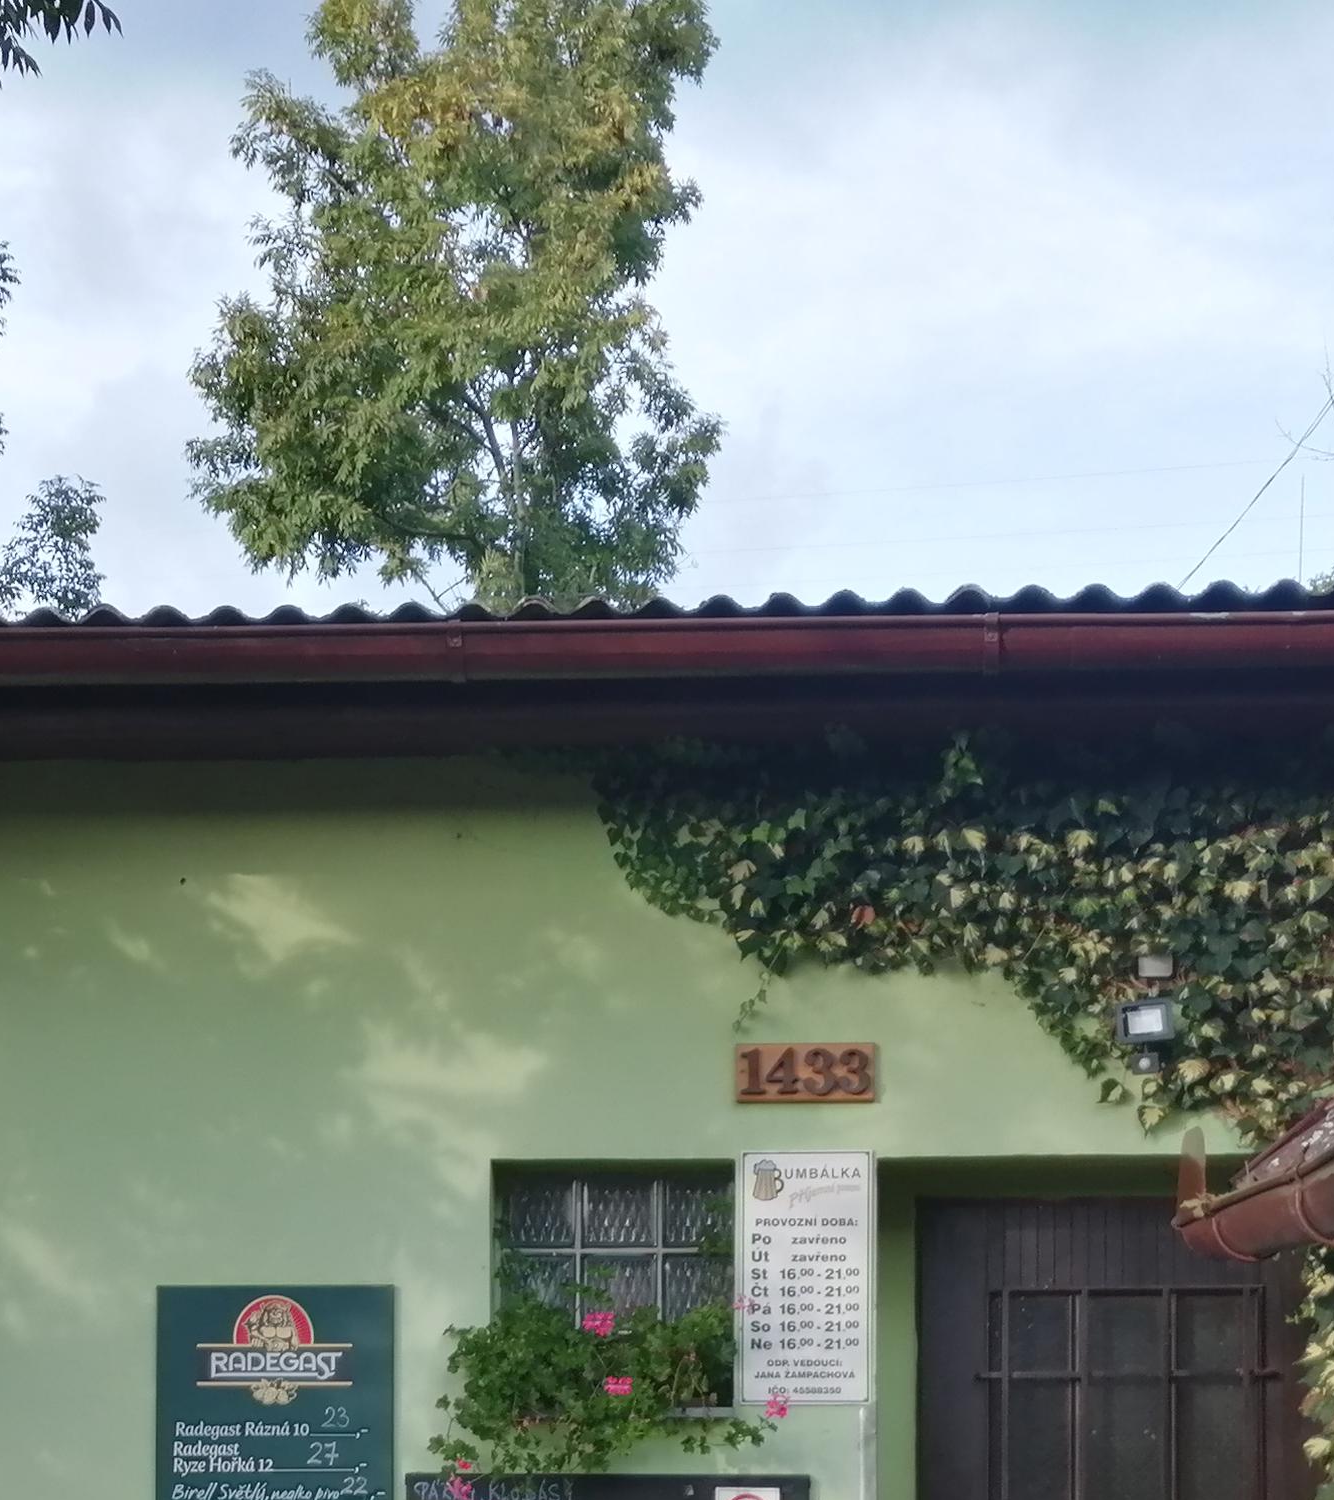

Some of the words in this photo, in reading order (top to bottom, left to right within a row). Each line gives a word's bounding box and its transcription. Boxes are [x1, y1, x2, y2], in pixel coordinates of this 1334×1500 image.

[740, 1048, 871, 1096] 1433
[755, 1214, 817, 1227] PROVOZNÍ
[821, 1217, 858, 1227] DOBA:
[751, 1233, 772, 1245] Po
[791, 1234, 847, 1245] zavřeno
[751, 1247, 770, 1262] Út
[791, 1251, 847, 1262] zavřeno
[751, 1268, 768, 1280] St
[751, 1282, 769, 1297] Čt
[751, 1302, 772, 1315] Pá
[750, 1320, 771, 1332] So
[750, 1338, 772, 1350] Ne
[210, 1351, 343, 1380] RADEGAST
[767, 1359, 790, 1367] ODP.
[754, 1371, 781, 1379] JANA
[175, 1421, 241, 1439] Radegast
[245, 1421, 290, 1437] Rázná
[293, 1423, 310, 1437] 10
[173, 1441, 240, 1459] Radegast
[173, 1457, 205, 1477] Ryze
[208, 1456, 255, 1473] Hořká
[258, 1458, 274, 1473] 12
[171, 1481, 218, 1500] Birell
[271, 1484, 312, 1500] nealko
